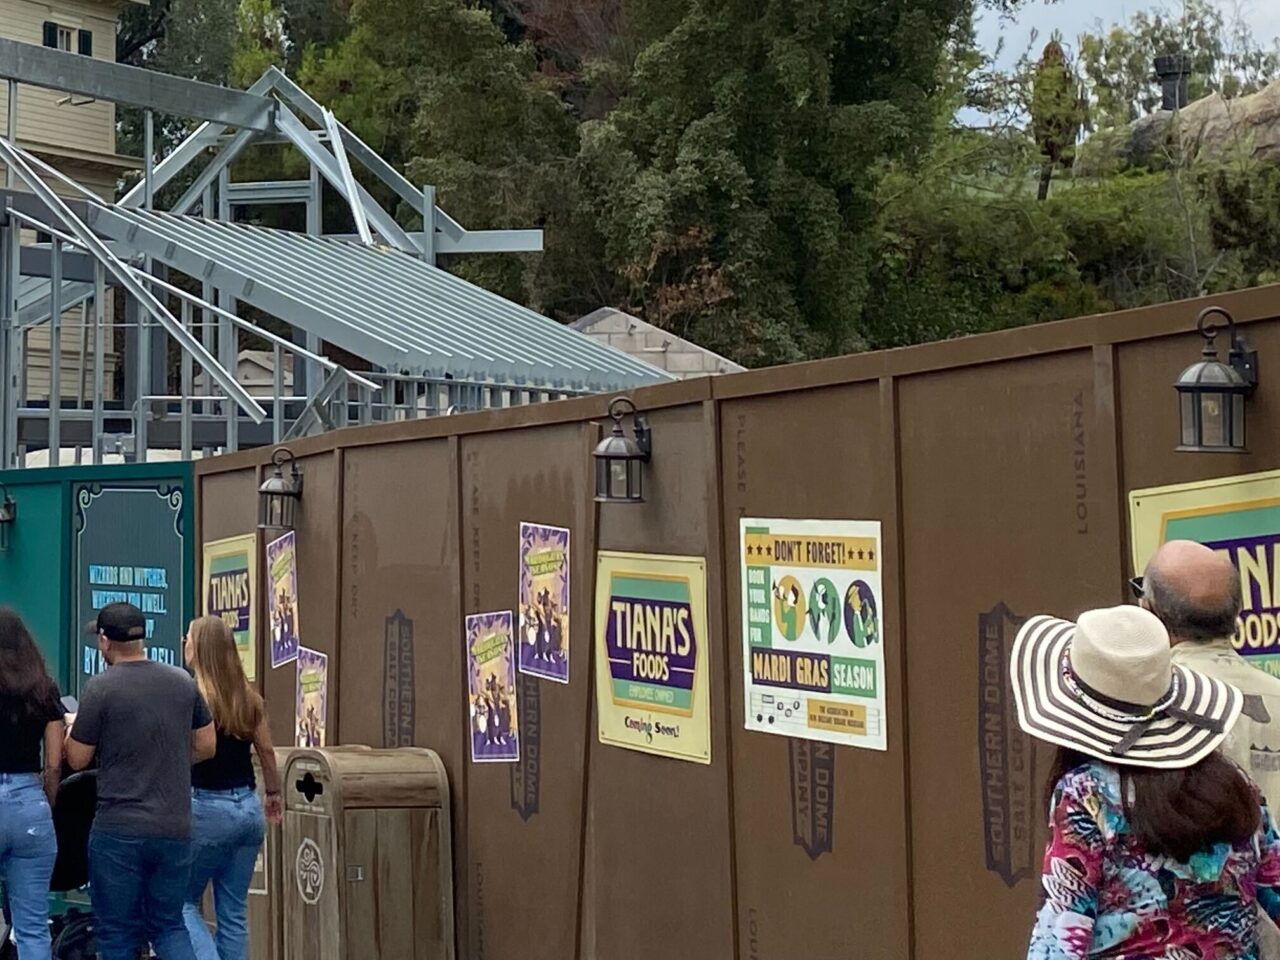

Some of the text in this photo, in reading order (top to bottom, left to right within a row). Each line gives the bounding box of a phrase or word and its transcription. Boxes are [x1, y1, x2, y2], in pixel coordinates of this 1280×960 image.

[736, 415, 747, 492] PLEASE
[1072, 391, 1089, 535] LOUISIANA
[774, 540, 846, 564] DON'T FORGET!
[211, 572, 249, 611] TIANA'S
[612, 601, 691, 656] TIANA'S
[1230, 612, 1280, 649] OOD
[84, 645, 97, 676] BY
[400, 625, 413, 729] SOUTHERN
[633, 653, 669, 681] FOODS
[753, 652, 874, 690] MARDI GRAS SEASON
[526, 682, 538, 804] HERN DOME
[625, 714, 653, 744] Coming
[984, 621, 1006, 863] SOUTHERN DOME
[797, 739, 809, 817] MPANY
[815, 767, 830, 843] DOME
